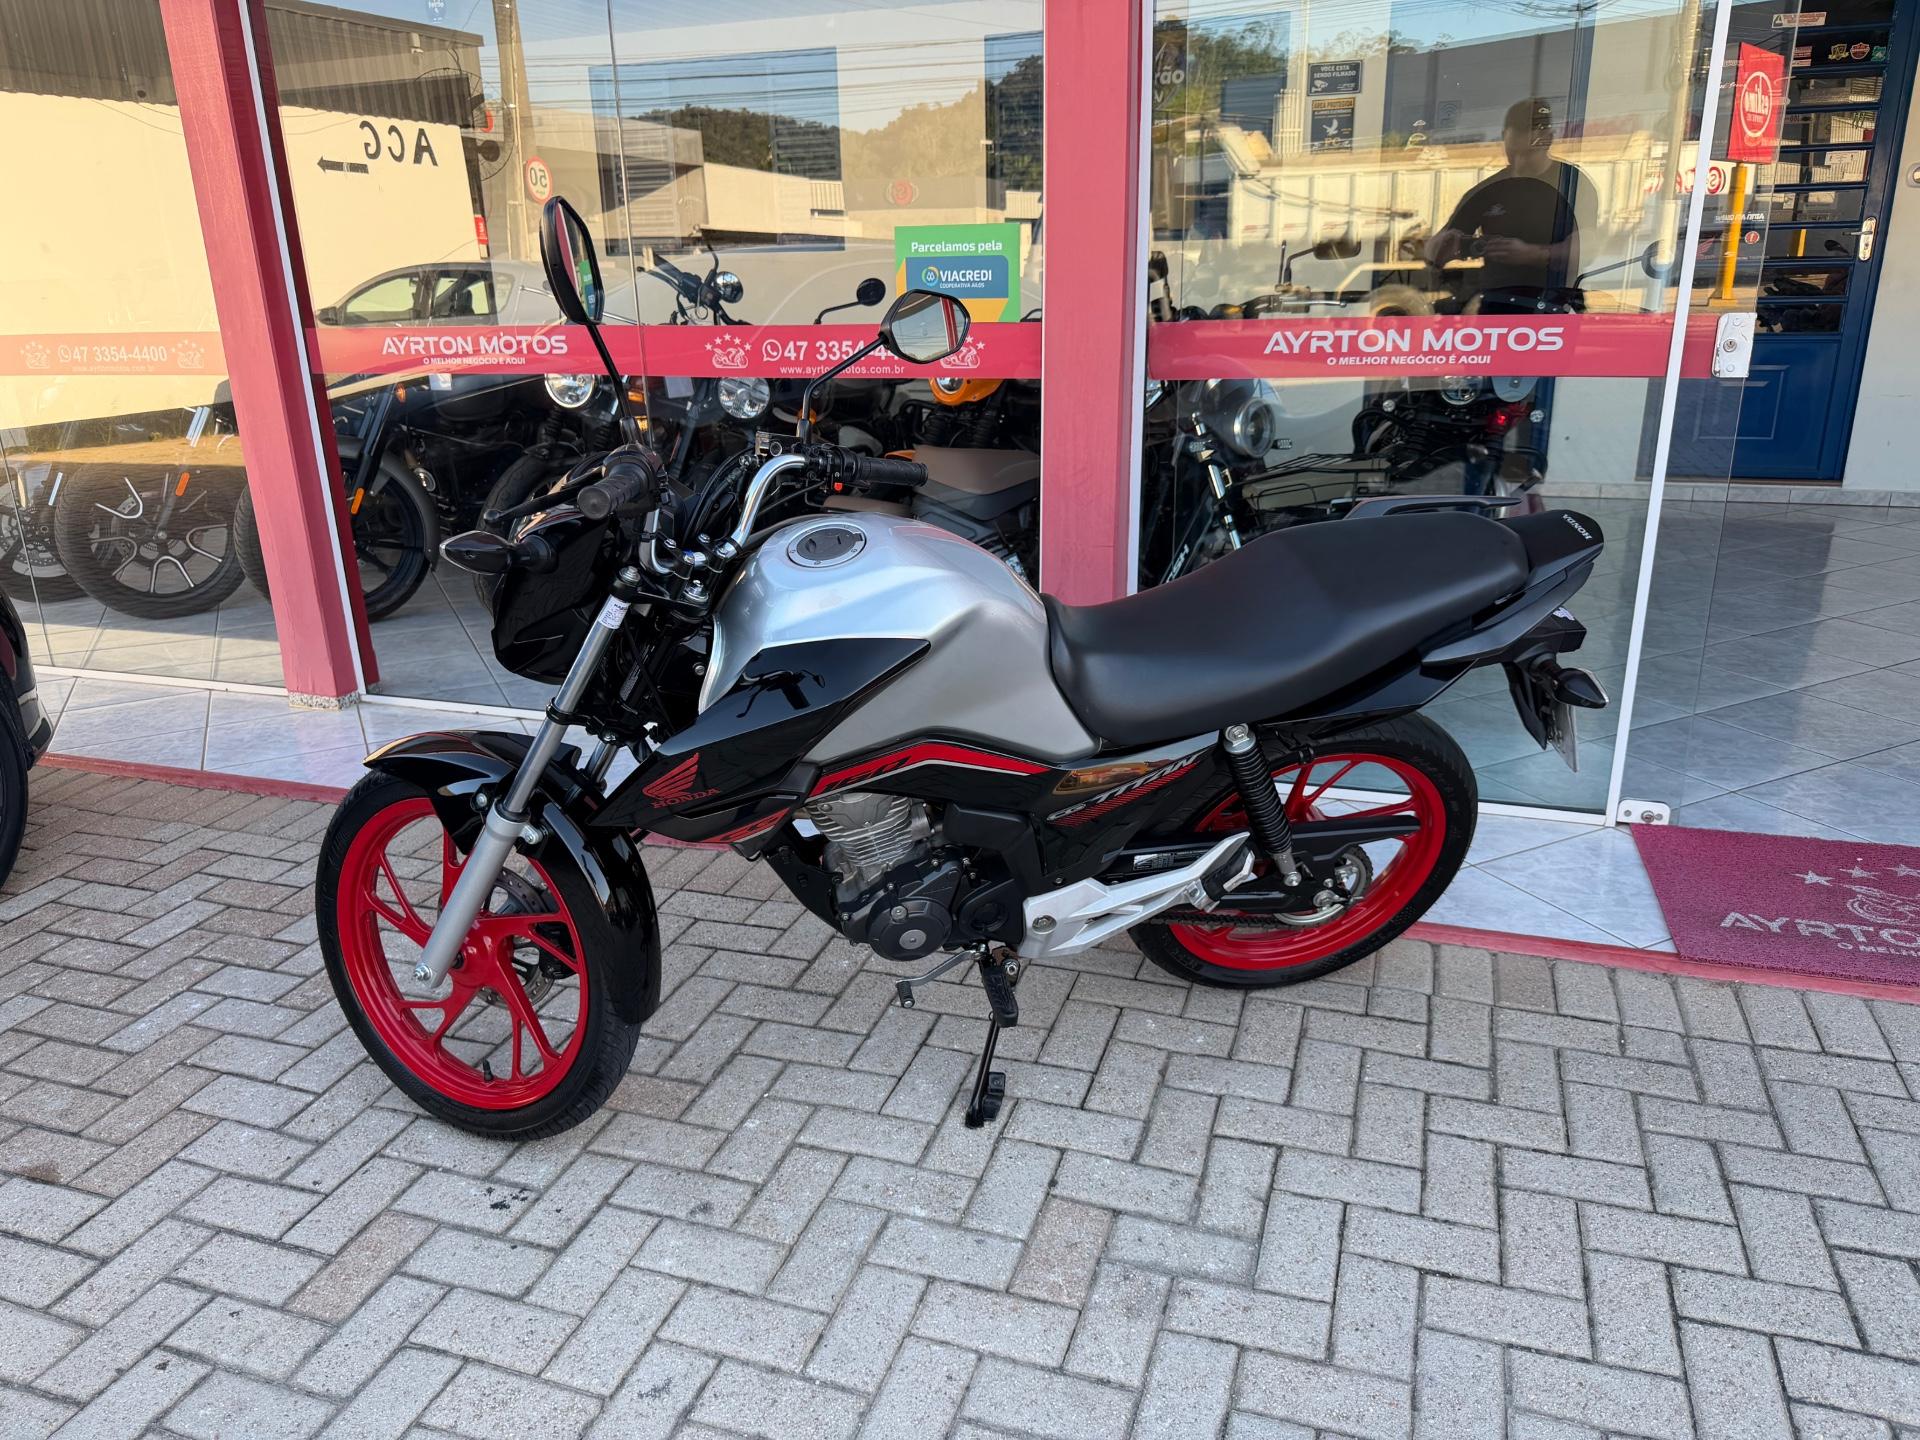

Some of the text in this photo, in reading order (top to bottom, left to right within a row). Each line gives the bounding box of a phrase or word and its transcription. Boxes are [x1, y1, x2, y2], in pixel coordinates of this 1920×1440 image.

[911, 240, 1003, 253] Parcelamos pela
[940, 269, 992, 282] VIACREDI
[382, 335, 568, 355] AYRTON MOTOS
[1263, 326, 1564, 354] AYRTON MOTOS
[73, 345, 167, 362] 47 3354-4400
[784, 341, 809, 361] 47
[1326, 357, 1337, 366] O
[1338, 356, 1388, 366] MELHOR
[1390, 353, 1446, 365] NEGÓCIO
[1458, 355, 1491, 364] AQUI
[423, 357, 430, 365] O
[431, 357, 461, 365] MELHOR
[505, 357, 526, 365] AQUI
[1562, 513, 1593, 540] HONDA
[650, 787, 722, 809] HONDA
